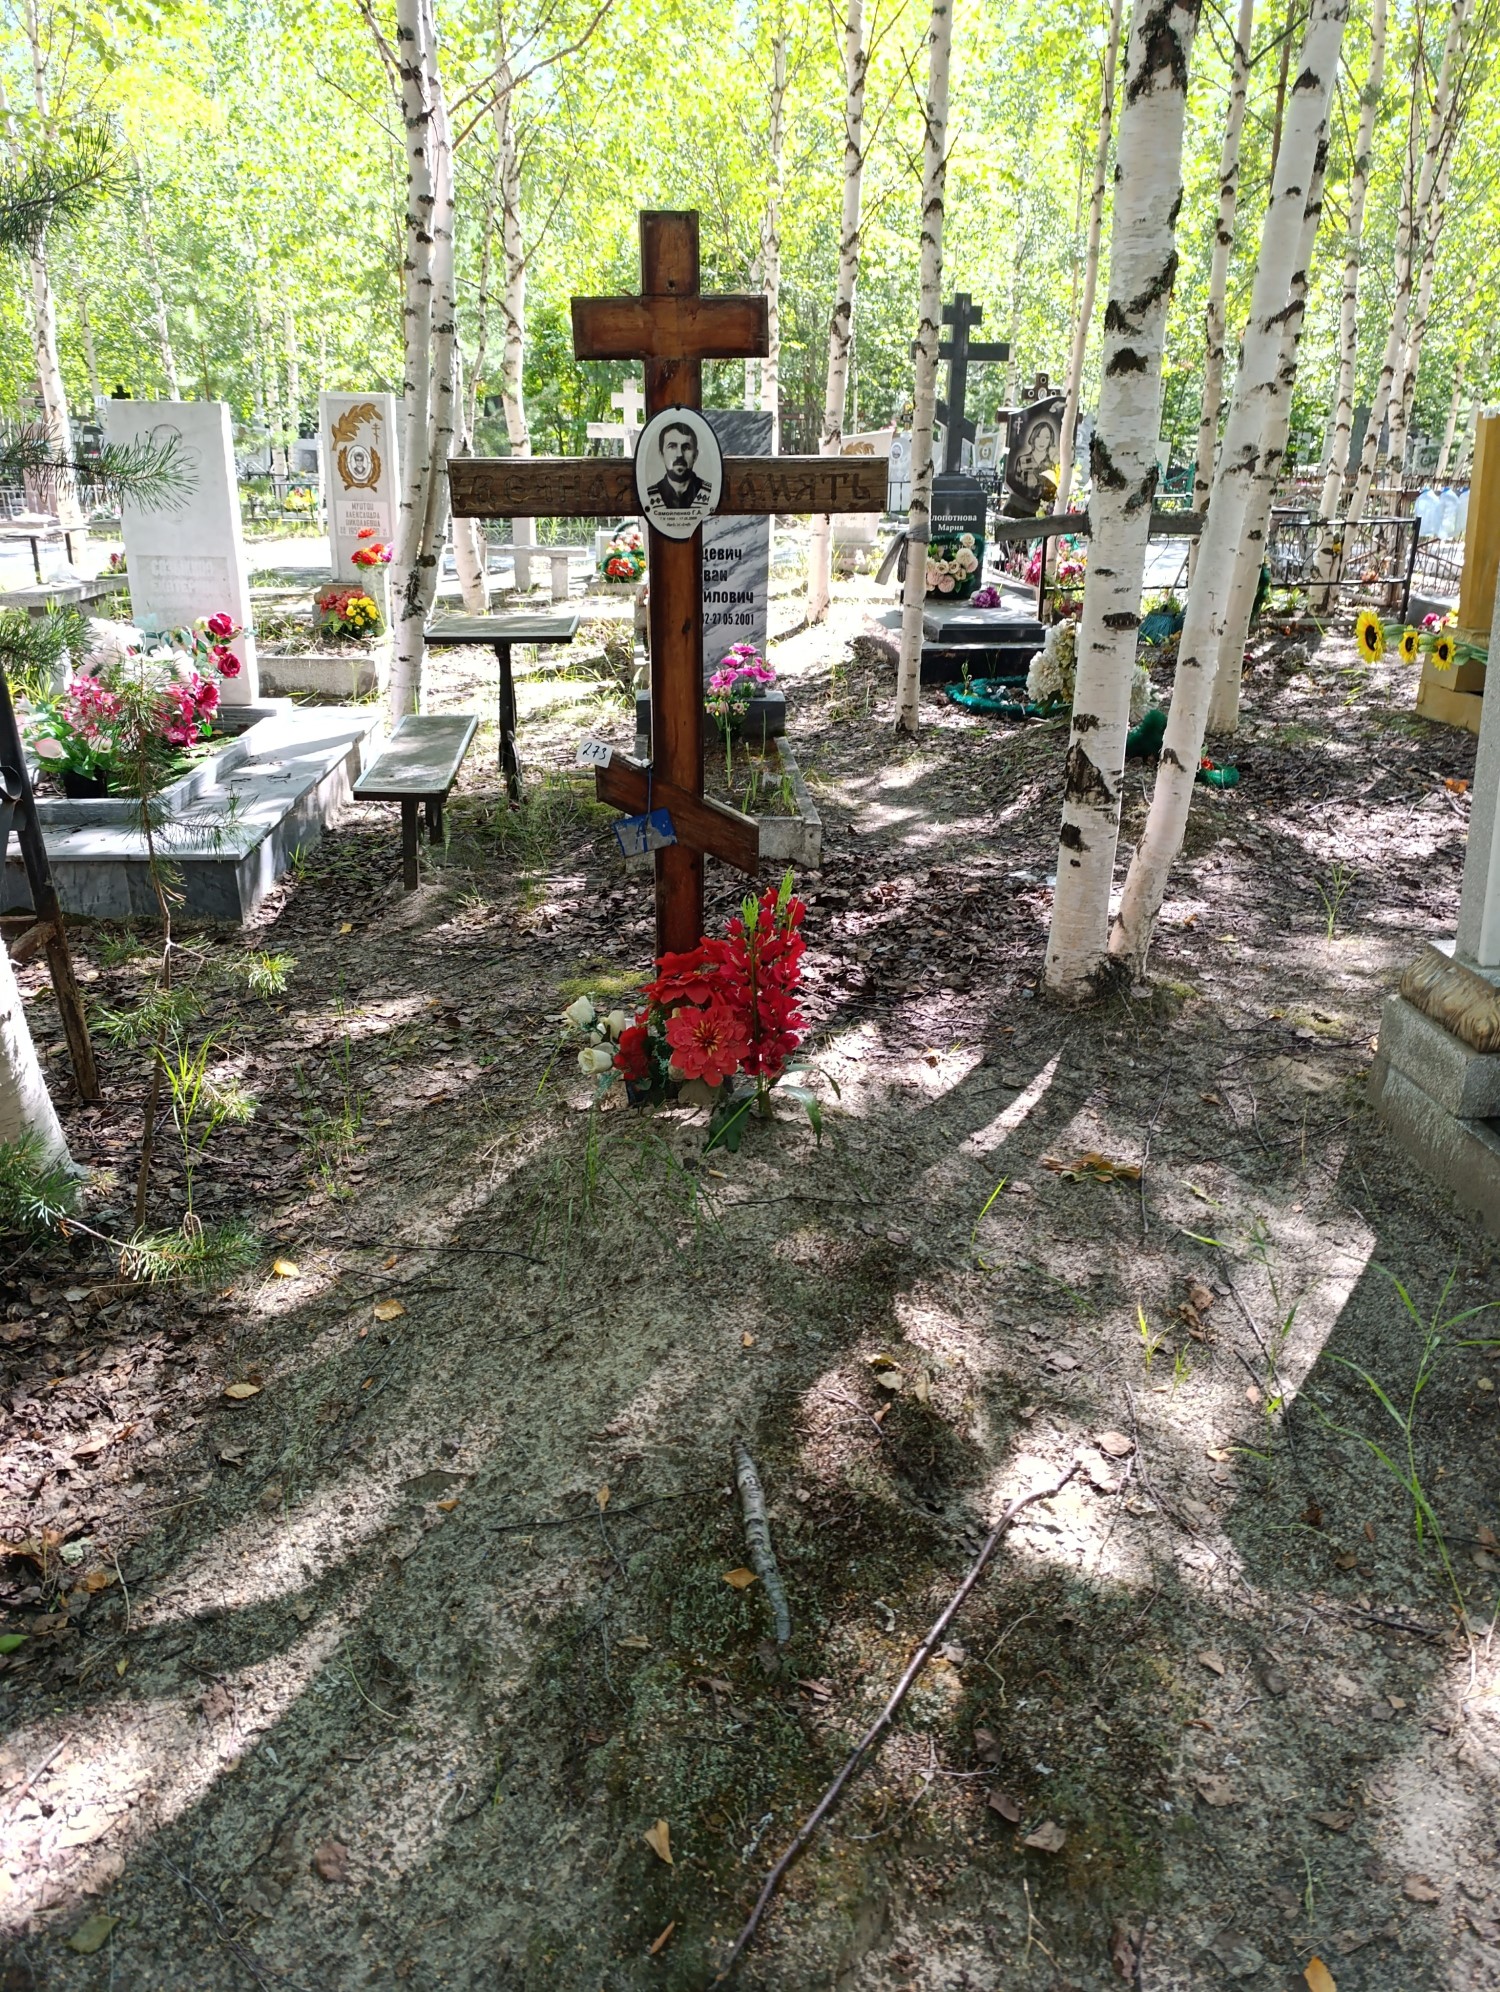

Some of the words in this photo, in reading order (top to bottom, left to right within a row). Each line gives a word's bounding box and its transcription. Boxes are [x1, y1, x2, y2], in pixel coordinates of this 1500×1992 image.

[937, 524, 964, 533] Мария
[703, 569, 728, 581] ван
[703, 587, 754, 604] йлович
[582, 741, 607, 760] 273
